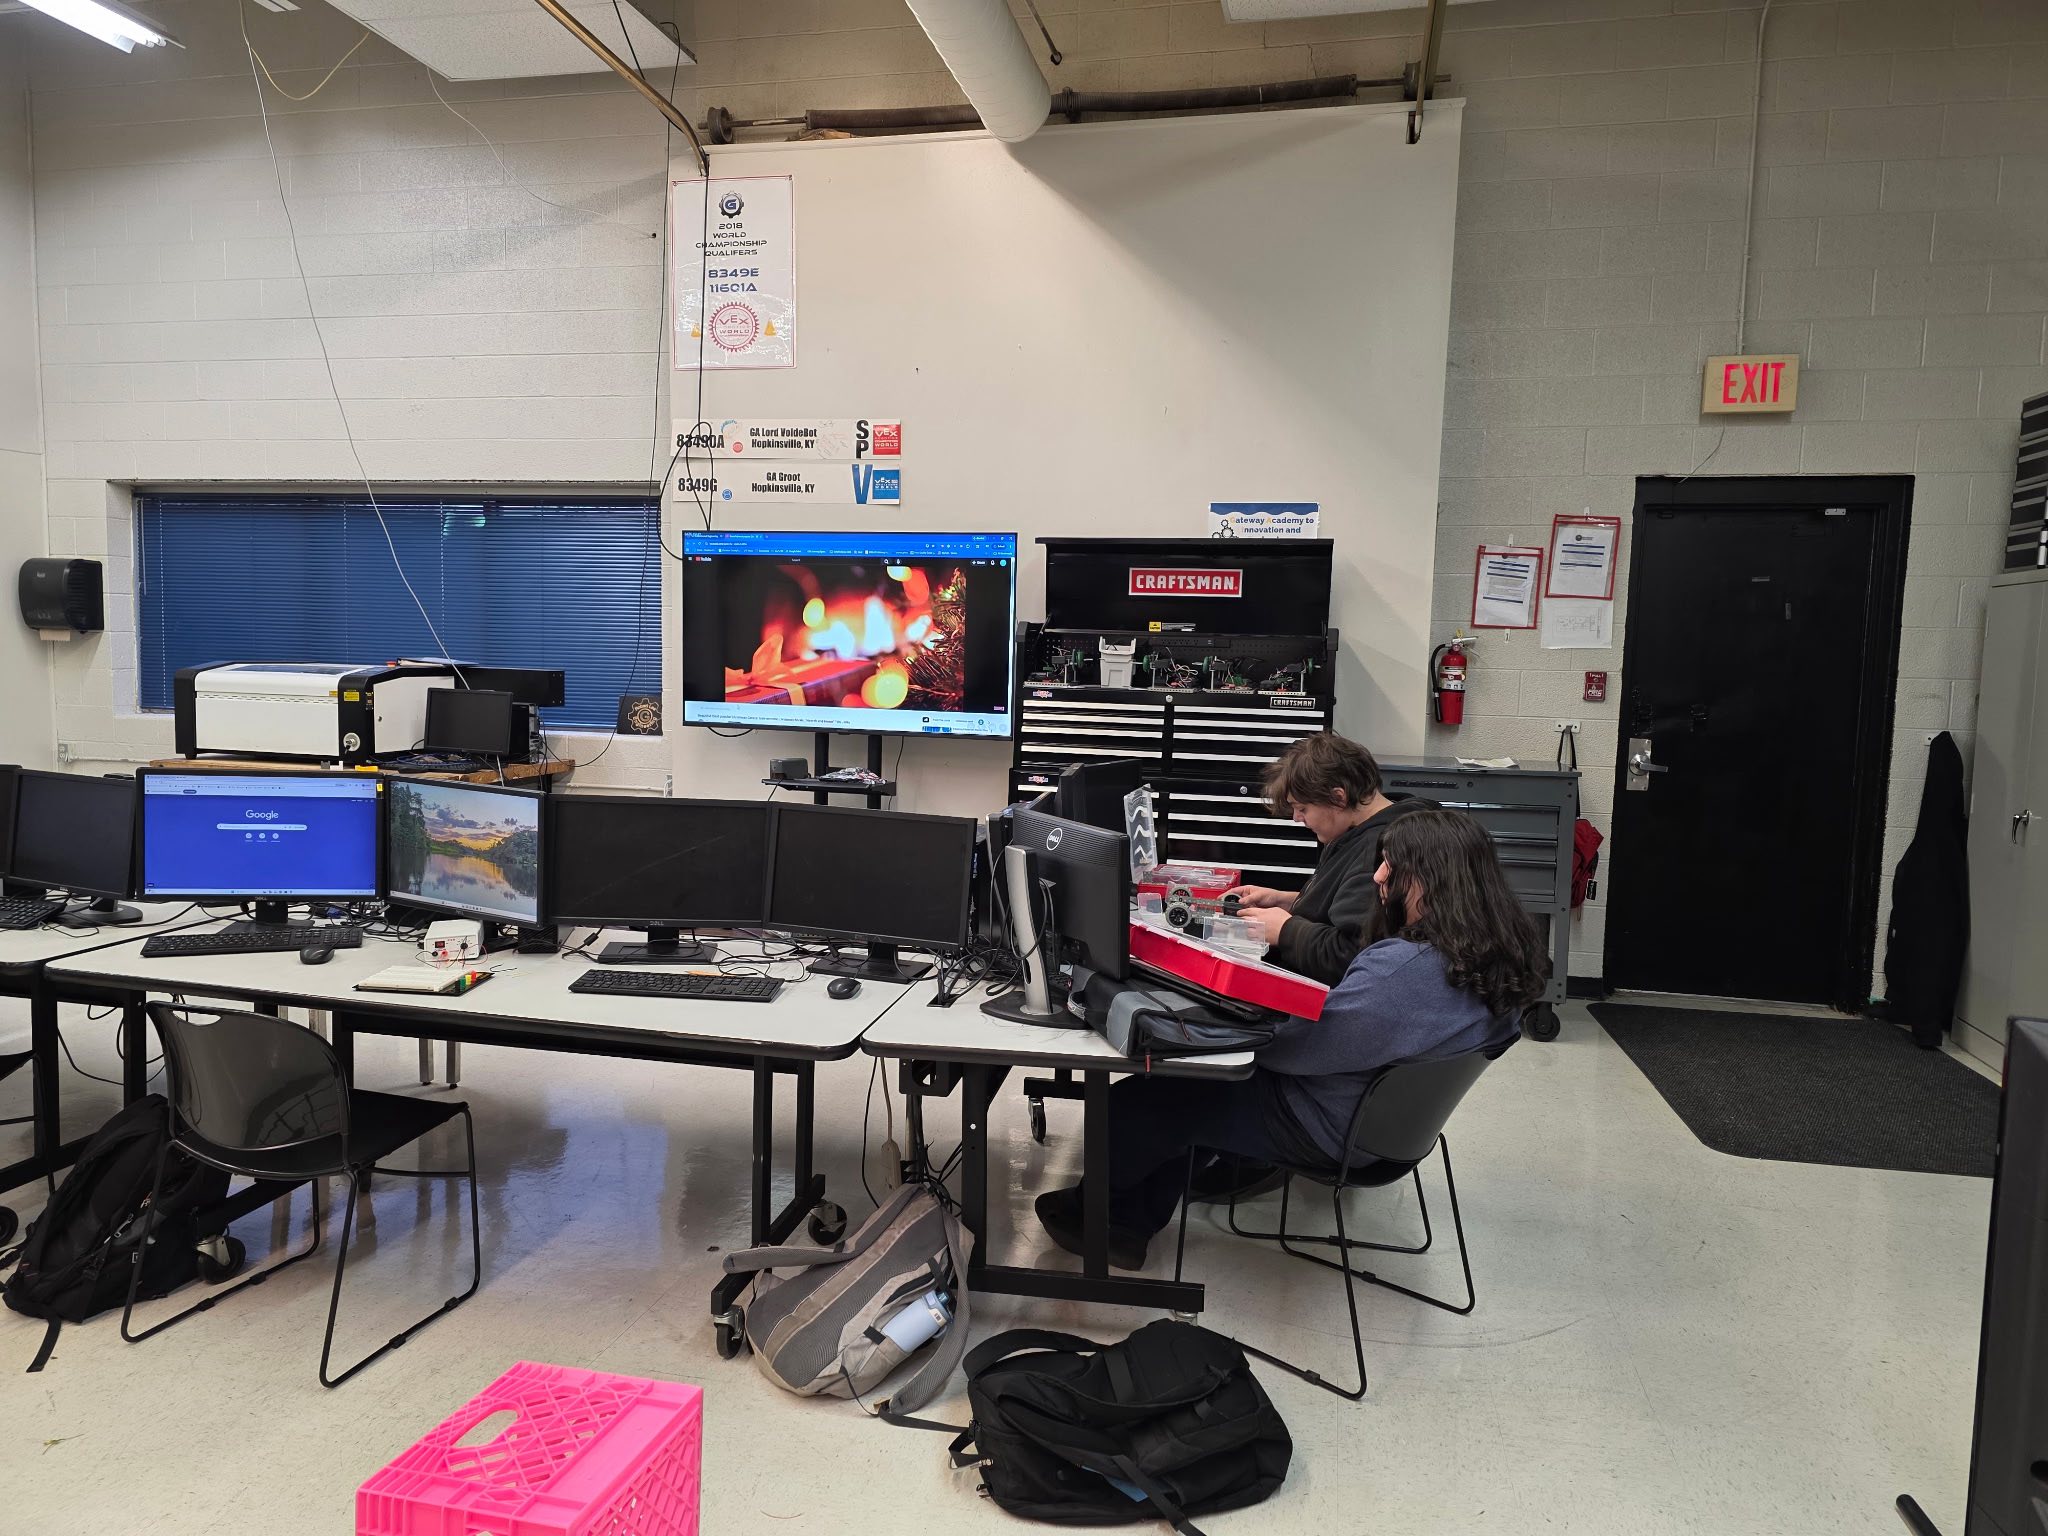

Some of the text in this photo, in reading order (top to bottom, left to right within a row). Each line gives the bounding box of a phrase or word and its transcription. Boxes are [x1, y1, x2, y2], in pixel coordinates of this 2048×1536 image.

[718, 222, 743, 230] 2018
[695, 240, 768, 249] CHAMPIONSHIP
[704, 249, 758, 257] QUALIFERS
[708, 267, 760, 279] 8349E
[709, 282, 758, 293] 11601A
[719, 314, 749, 325] VEX
[1722, 362, 1786, 404] EXIT
[749, 427, 760, 437] GA
[761, 427, 779, 437] Lord
[780, 427, 818, 438] VoldeBot
[875, 427, 898, 437] VEX
[751, 438, 815, 450] Hopkinsville, KY
[766, 471, 801, 482] GA Groot
[677, 477, 718, 492] 8349G
[751, 482, 816, 494] Hopkinsville, KY
[852, 463, 873, 505] V
[1266, 516, 1304, 526] Academy
[1305, 516, 1315, 524] to
[1285, 526, 1302, 534] and
[1135, 574, 1235, 590] CRAFTSMAN
[1273, 699, 1313, 707] CRAFTSMAN
[245, 809, 279, 821] Google
